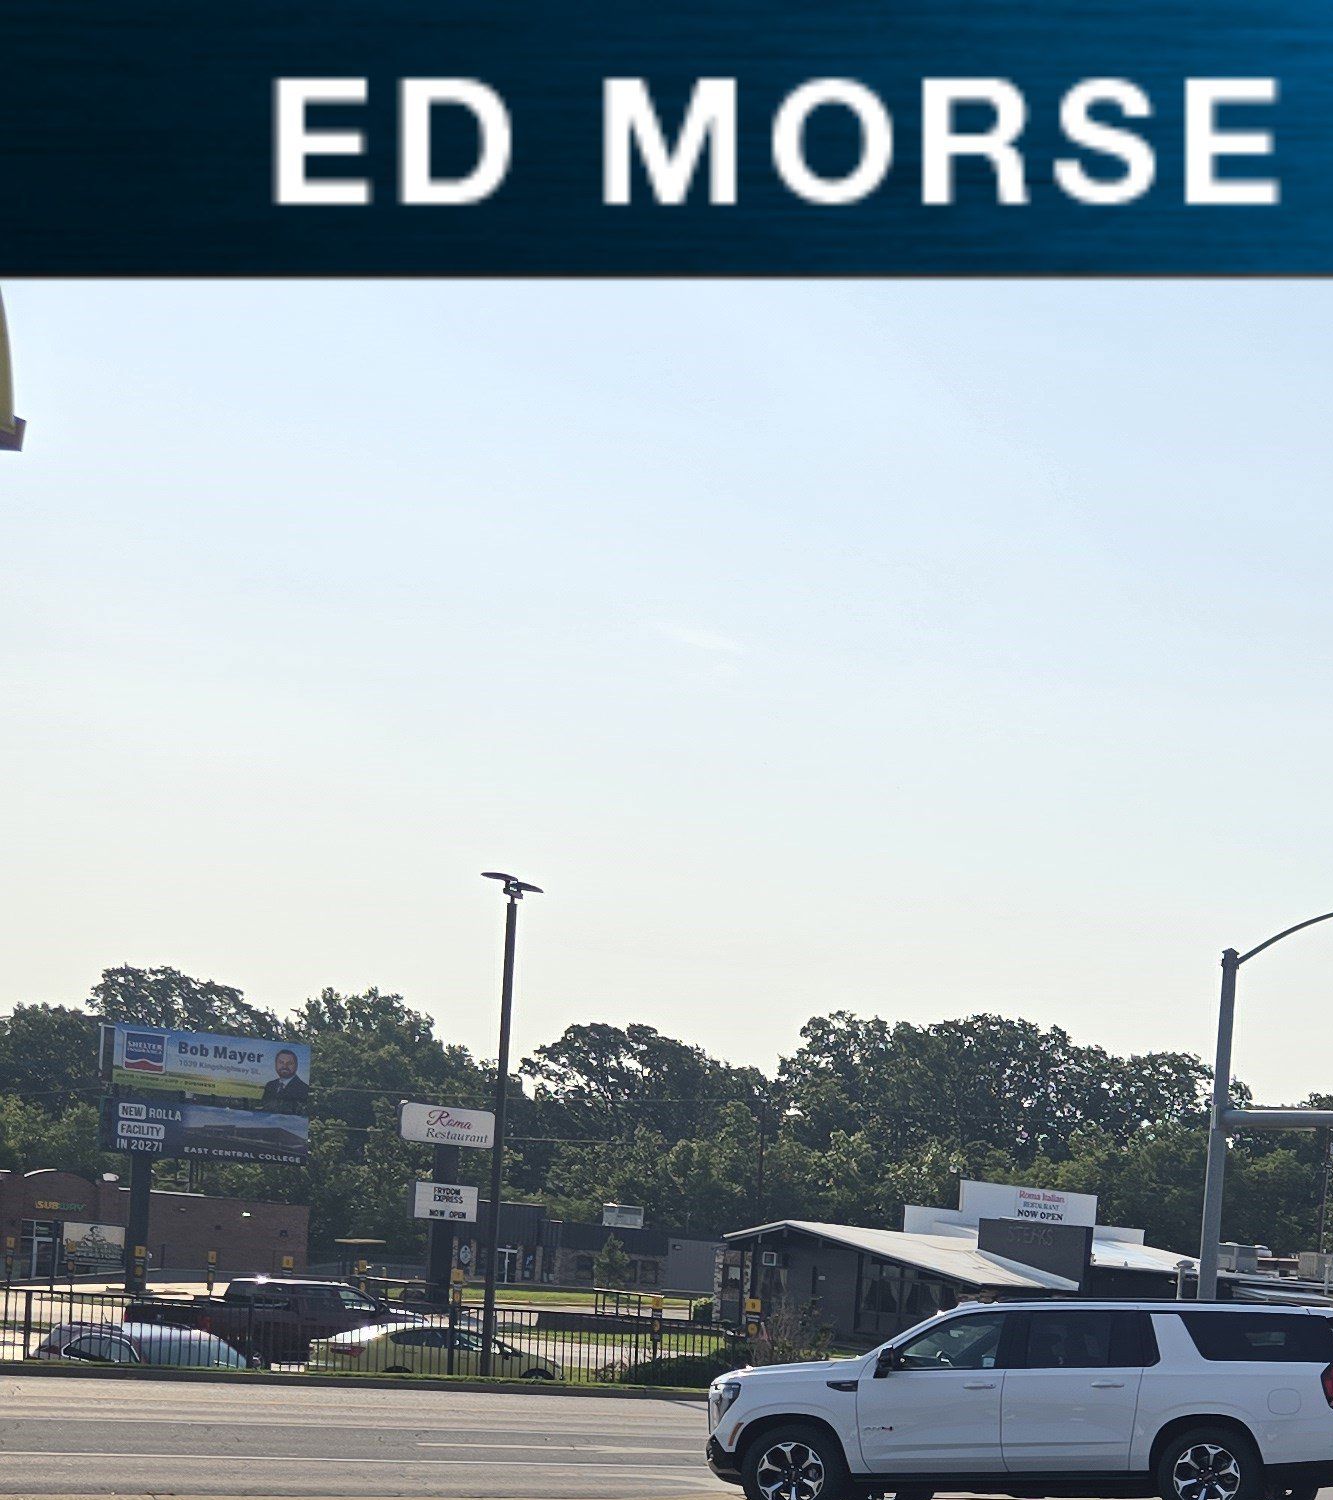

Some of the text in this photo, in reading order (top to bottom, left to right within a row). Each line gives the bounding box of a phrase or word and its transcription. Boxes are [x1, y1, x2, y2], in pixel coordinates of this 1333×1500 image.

[178, 1041, 264, 1064] Bob Mayer
[121, 1105, 182, 1122] NEW ROLLA
[426, 1109, 474, 1130] Roma
[120, 1123, 162, 1137] FACILITY
[426, 1127, 489, 1143] Restaurant
[116, 1138, 128, 1150] IN
[184, 1146, 301, 1164] EAST CENTRAL COLLEGE
[433, 1195, 464, 1204] EXPRESS
[1019, 1189, 1066, 1203] Roma Italian
[34, 1200, 87, 1212] SUBWAY
[429, 1208, 467, 1219] NOW OPEN
[1017, 1209, 1064, 1221] NOW OPEN
